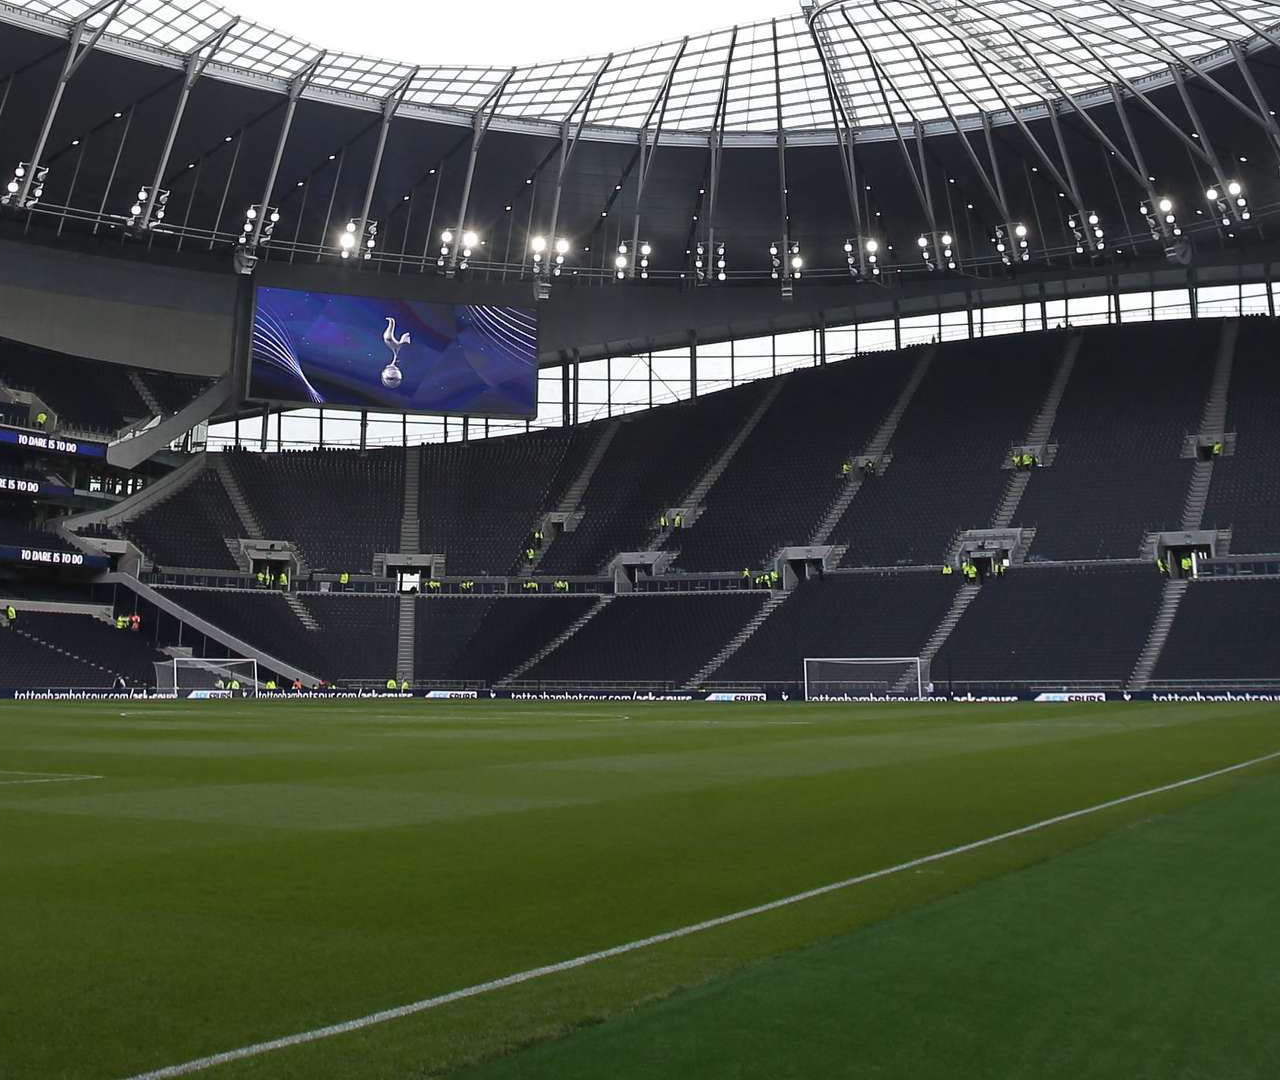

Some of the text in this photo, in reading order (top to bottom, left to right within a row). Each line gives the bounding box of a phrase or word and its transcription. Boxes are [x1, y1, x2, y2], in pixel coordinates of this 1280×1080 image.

[18, 435, 76, 452] TO DARE IS TO DO
[7, 480, 15, 489] IS
[16, 481, 26, 490] TO
[27, 482, 38, 492] DO
[21, 550, 83, 564] TO DARE IS TO DO
